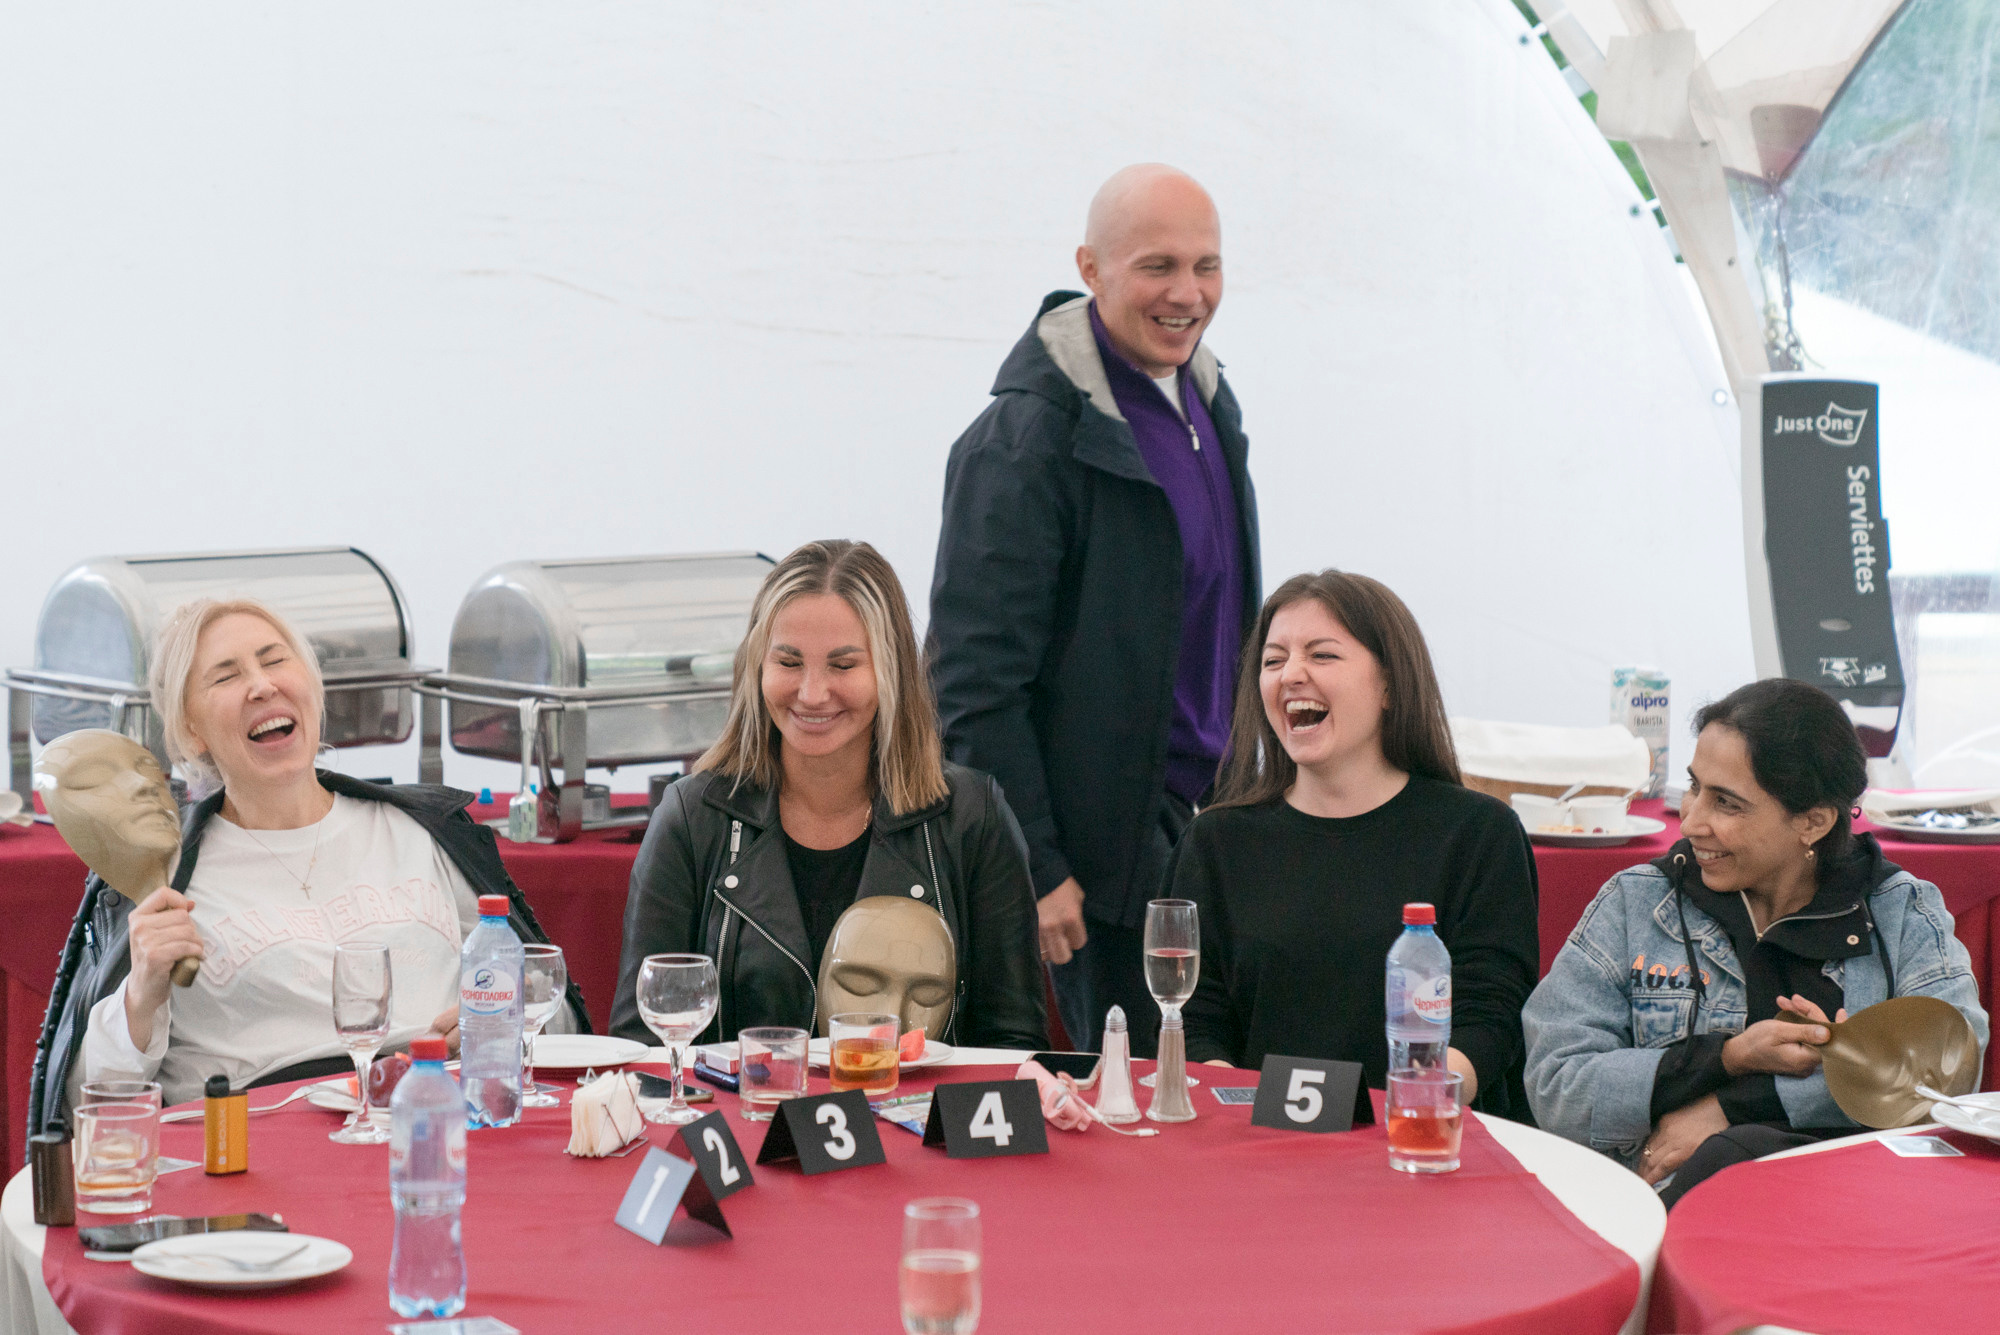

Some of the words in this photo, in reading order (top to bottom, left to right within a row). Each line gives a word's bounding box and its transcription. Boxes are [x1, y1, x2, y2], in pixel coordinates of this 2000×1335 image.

[1846, 465, 1877, 594] Serviettes
[1631, 691, 1669, 711] alpro
[968, 1090, 1014, 1147] 4
[1283, 1067, 1327, 1124] 5
[702, 1126, 741, 1187] 2
[814, 1102, 857, 1161] 3
[634, 1163, 670, 1227] 1
